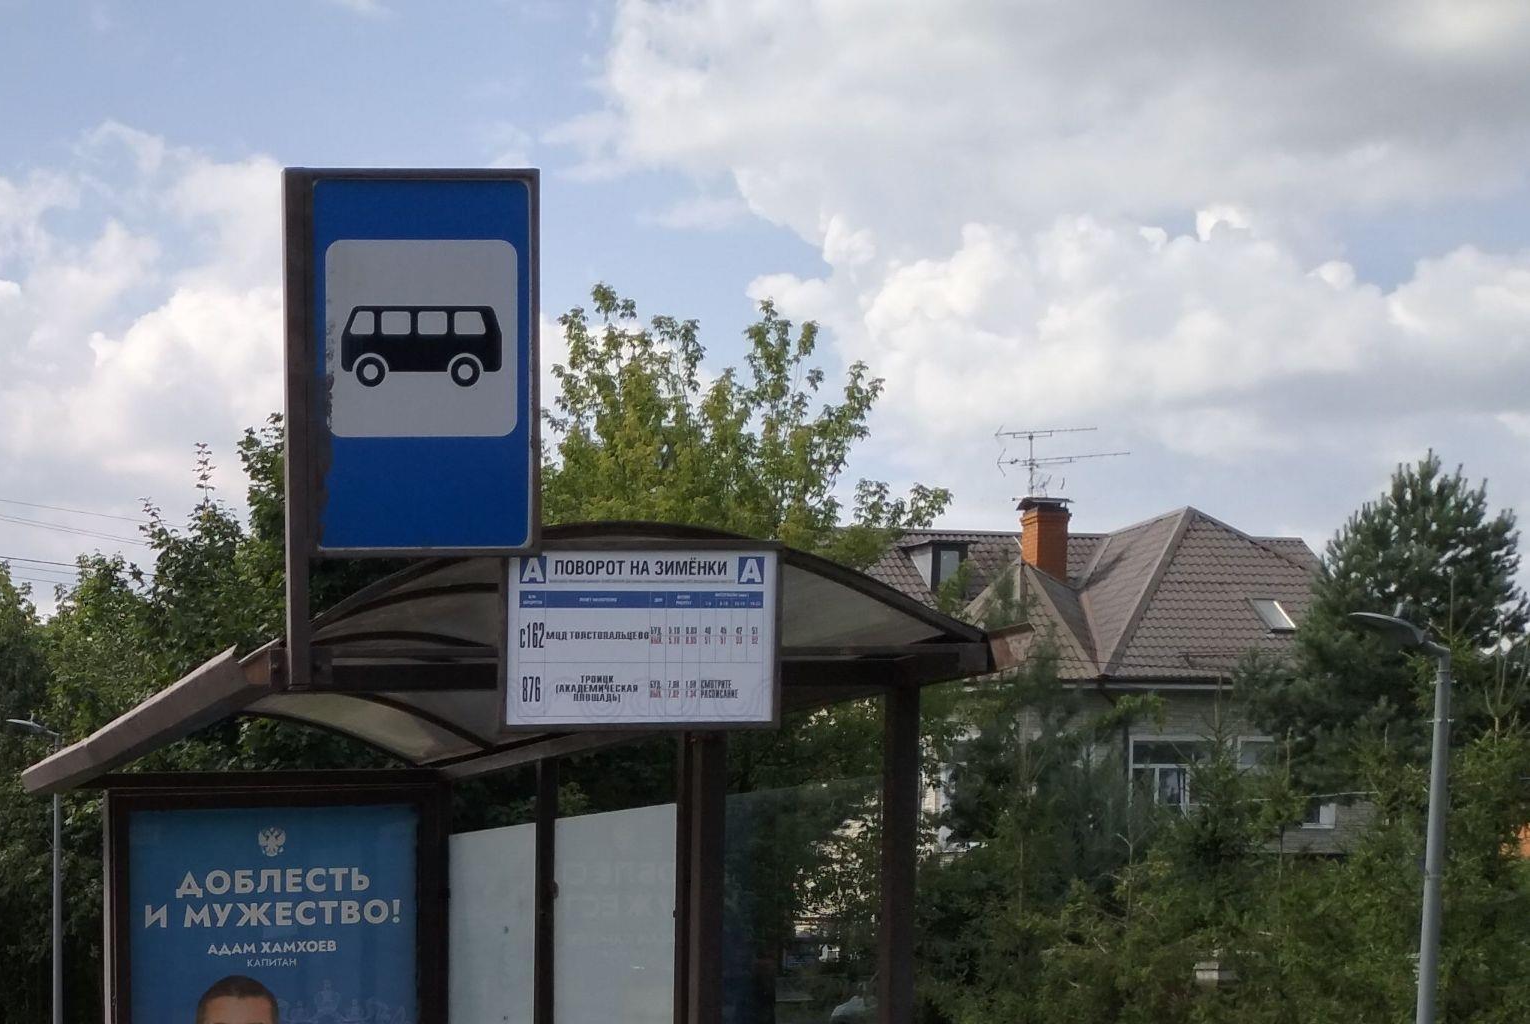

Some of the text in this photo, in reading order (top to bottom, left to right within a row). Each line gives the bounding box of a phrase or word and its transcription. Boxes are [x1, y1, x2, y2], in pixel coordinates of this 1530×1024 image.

[521, 558, 545, 583] А
[554, 557, 728, 576] ПОВОРОТ НА ЗИМЁНКИ
[739, 558, 763, 583] А
[522, 676, 542, 703] 876
[175, 866, 370, 899] ДОБЛЕСТЬ
[144, 899, 402, 929] И МУЖЕСТВО!
[207, 940, 338, 956] АДАМ ХАМХОЕВ
[246, 957, 297, 968] КАПИТАН
